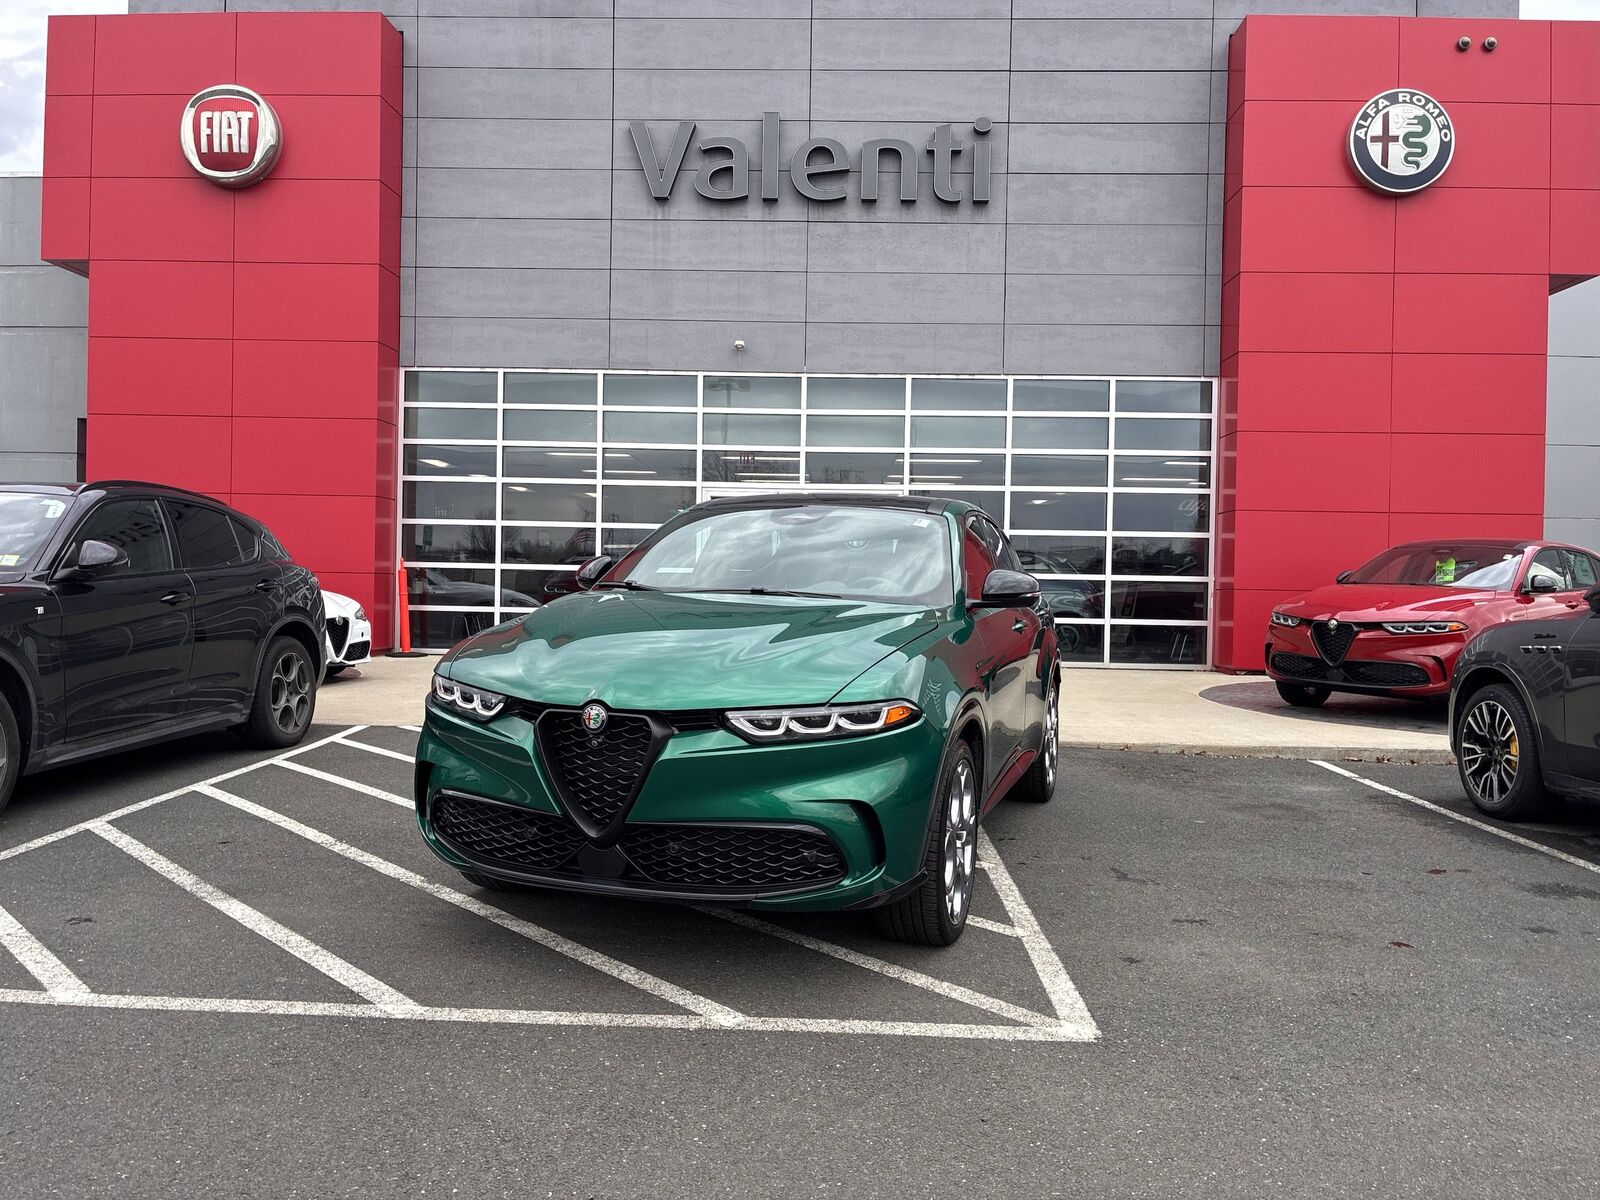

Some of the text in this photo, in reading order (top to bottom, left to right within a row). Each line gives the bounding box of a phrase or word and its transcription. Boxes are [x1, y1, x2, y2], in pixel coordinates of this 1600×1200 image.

[200, 110, 254, 153] FIAT
[1355, 92, 1451, 142] ALFA ROMEO
[627, 111, 993, 204] Valenti
